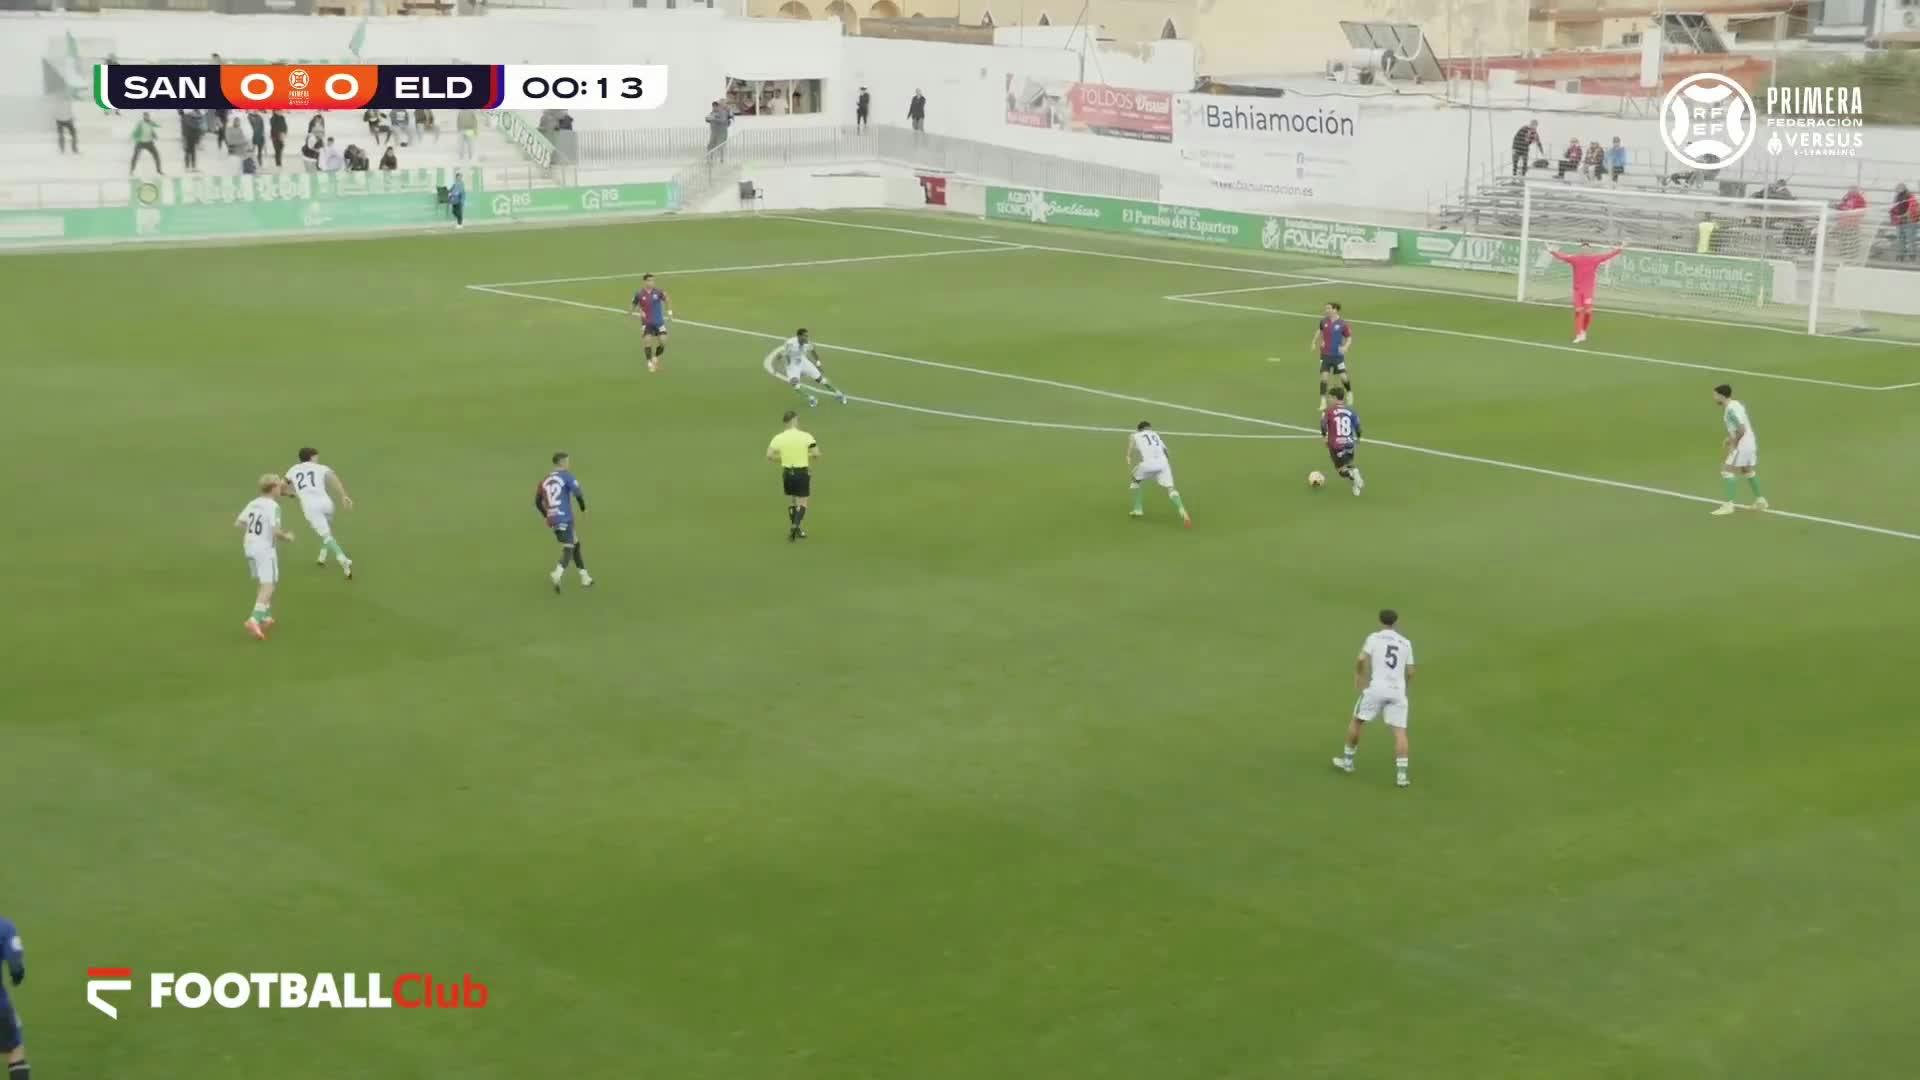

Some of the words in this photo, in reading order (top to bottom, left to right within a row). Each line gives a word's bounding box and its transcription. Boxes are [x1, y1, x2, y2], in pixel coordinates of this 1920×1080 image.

[1080, 87, 1133, 110] TOLDOS
[1206, 104, 1354, 137] Bahiamoción
[1334, 416, 1352, 436] 18
[295, 470, 315, 490] 21
[544, 483, 561, 507] 12
[248, 512, 262, 536] 26
[1385, 644, 1399, 670] 5
